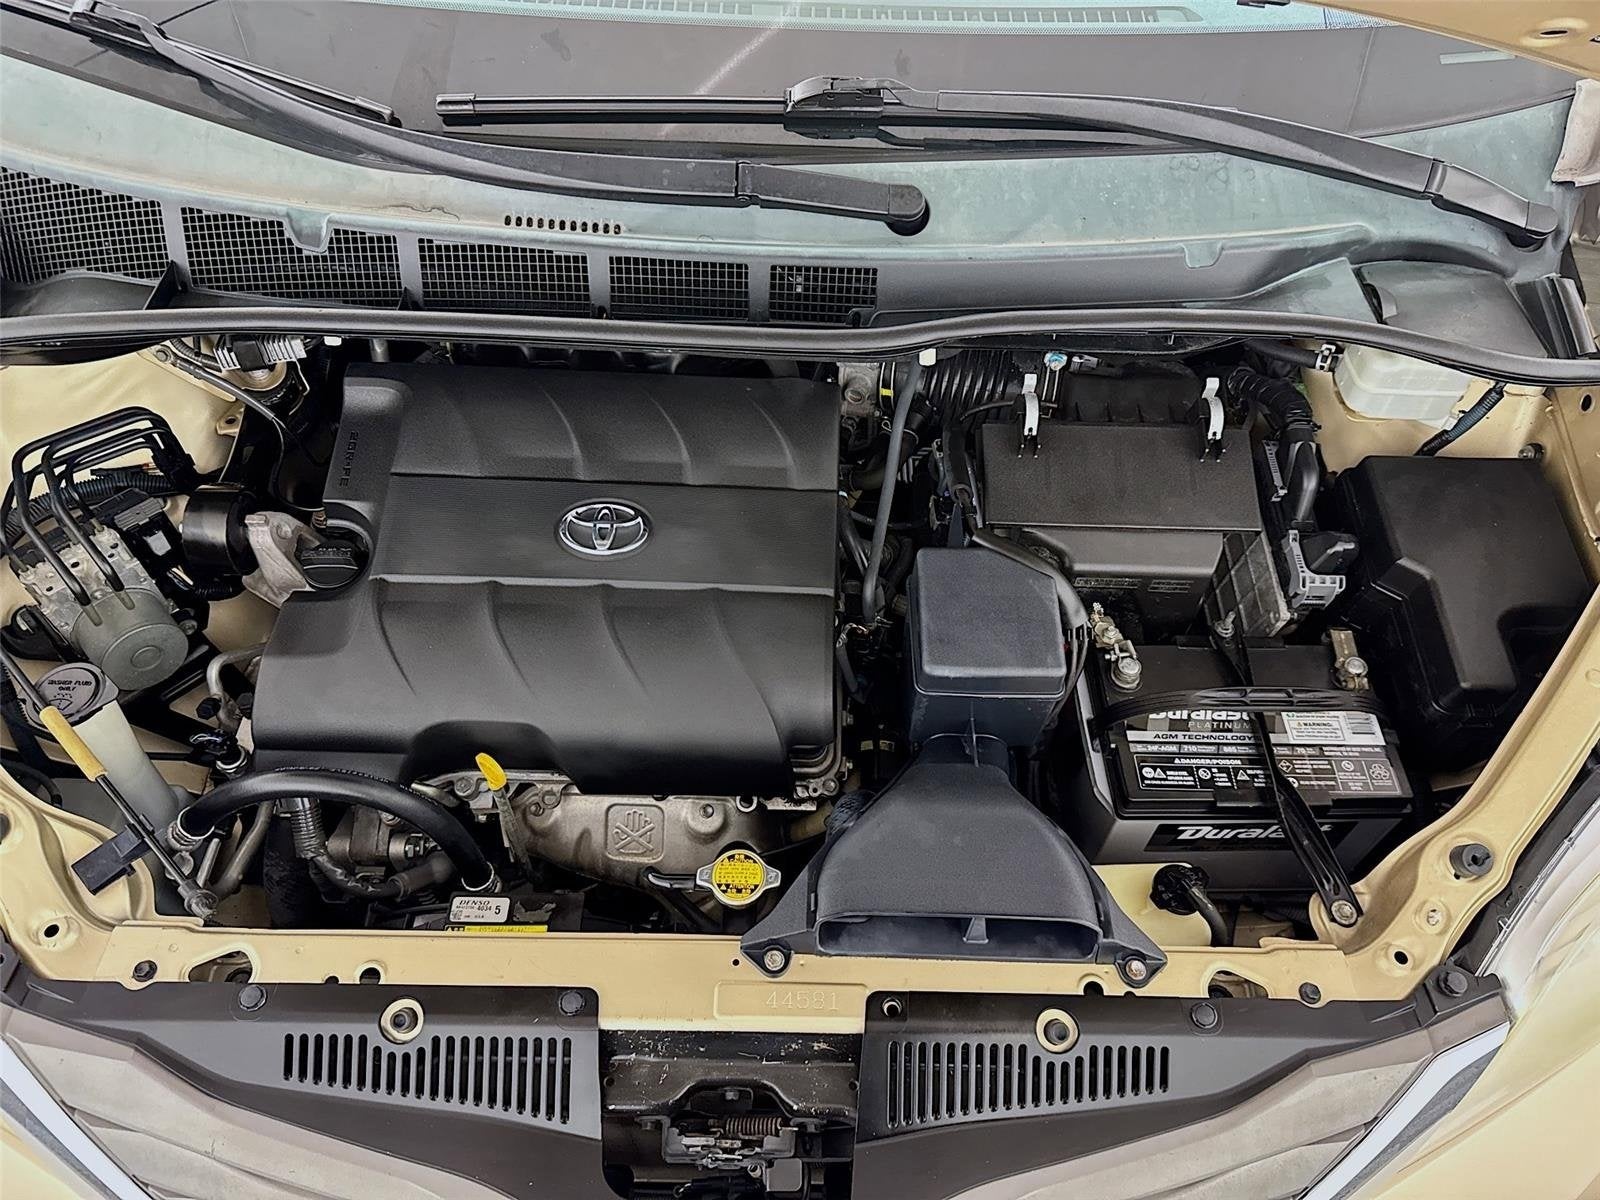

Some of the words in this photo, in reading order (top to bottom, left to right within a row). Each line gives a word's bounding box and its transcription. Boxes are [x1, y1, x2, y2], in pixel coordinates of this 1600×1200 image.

[1177, 825, 1332, 840] Duralat
[494, 905, 501, 915] 5
[766, 991, 840, 1011] 44581
